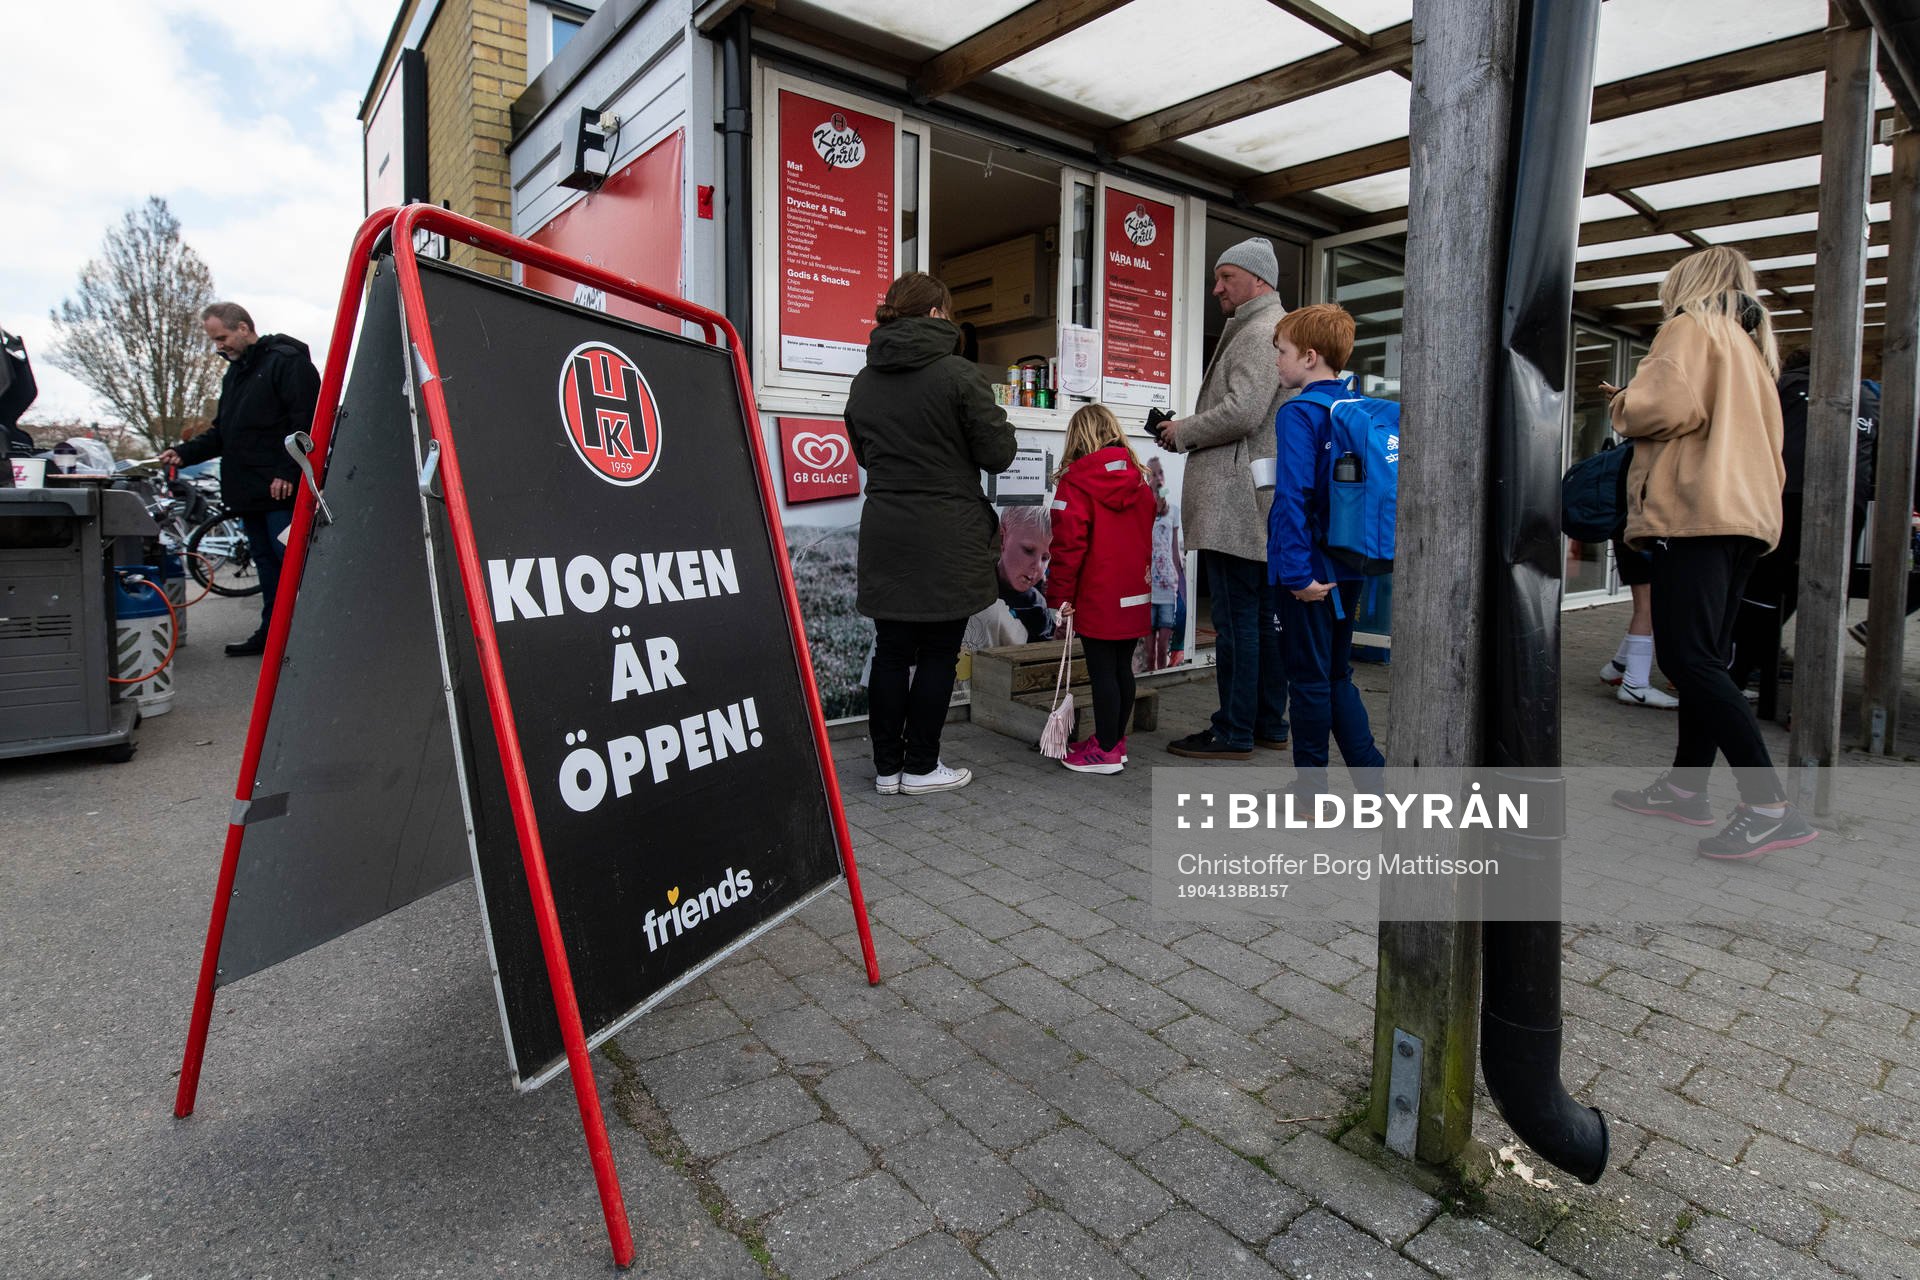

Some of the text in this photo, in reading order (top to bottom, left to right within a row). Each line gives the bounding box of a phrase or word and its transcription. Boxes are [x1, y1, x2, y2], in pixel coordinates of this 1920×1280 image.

[814, 128, 862, 148] Kiosk
[787, 161, 803, 171] Mat
[824, 147, 860, 171] Grill
[787, 196, 847, 217] Drycker & Fika
[1125, 215, 1154, 232] Kiosk
[1131, 229, 1153, 248] Grill
[1109, 250, 1152, 270] VÅRA MÅL
[787, 269, 850, 286] Godis & Snacks
[610, 461, 632, 473] 1959
[793, 472, 848, 483] GB GLACE
[487, 548, 740, 623] KIOSKEN
[611, 624, 687, 702] ÄR
[558, 696, 763, 812] ÖPPEN!
[642, 867, 753, 952] friends
